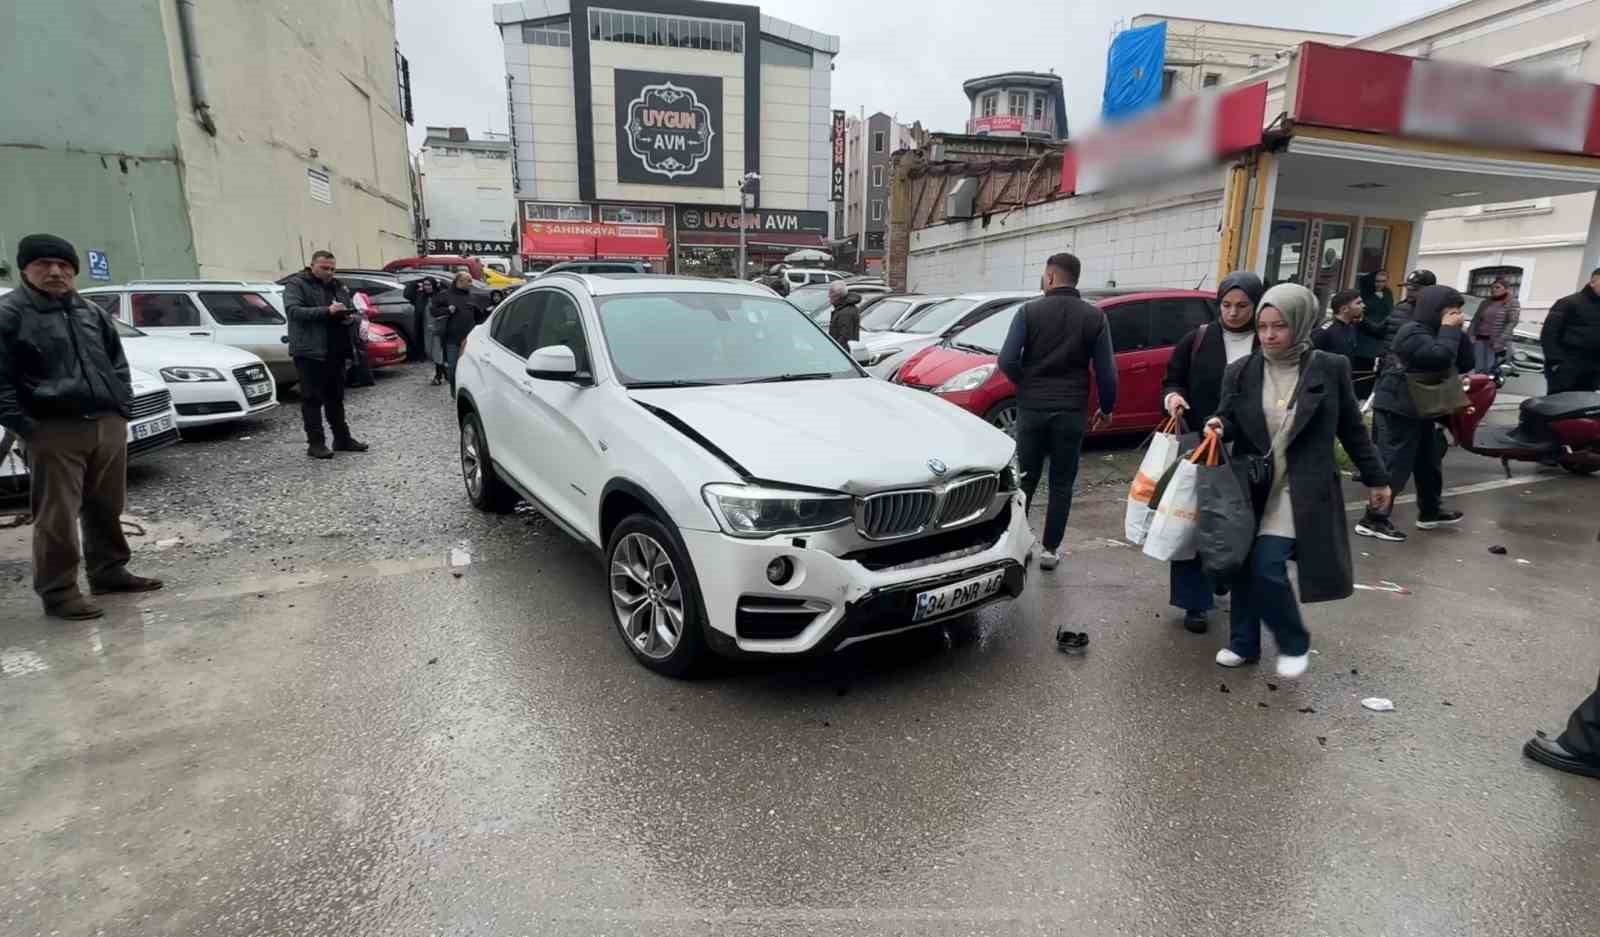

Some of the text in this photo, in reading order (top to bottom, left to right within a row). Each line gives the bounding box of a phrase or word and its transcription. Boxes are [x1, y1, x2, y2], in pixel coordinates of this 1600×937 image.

[642, 109, 697, 129] UYGUN
[653, 134, 686, 151] AVM
[834, 119, 844, 193] UYGUN AVM
[704, 211, 761, 229] UYGUN
[765, 215, 798, 230] AVM
[88, 251, 98, 269] P
[927, 593, 946, 614] 34
[950, 582, 980, 607] PNR
